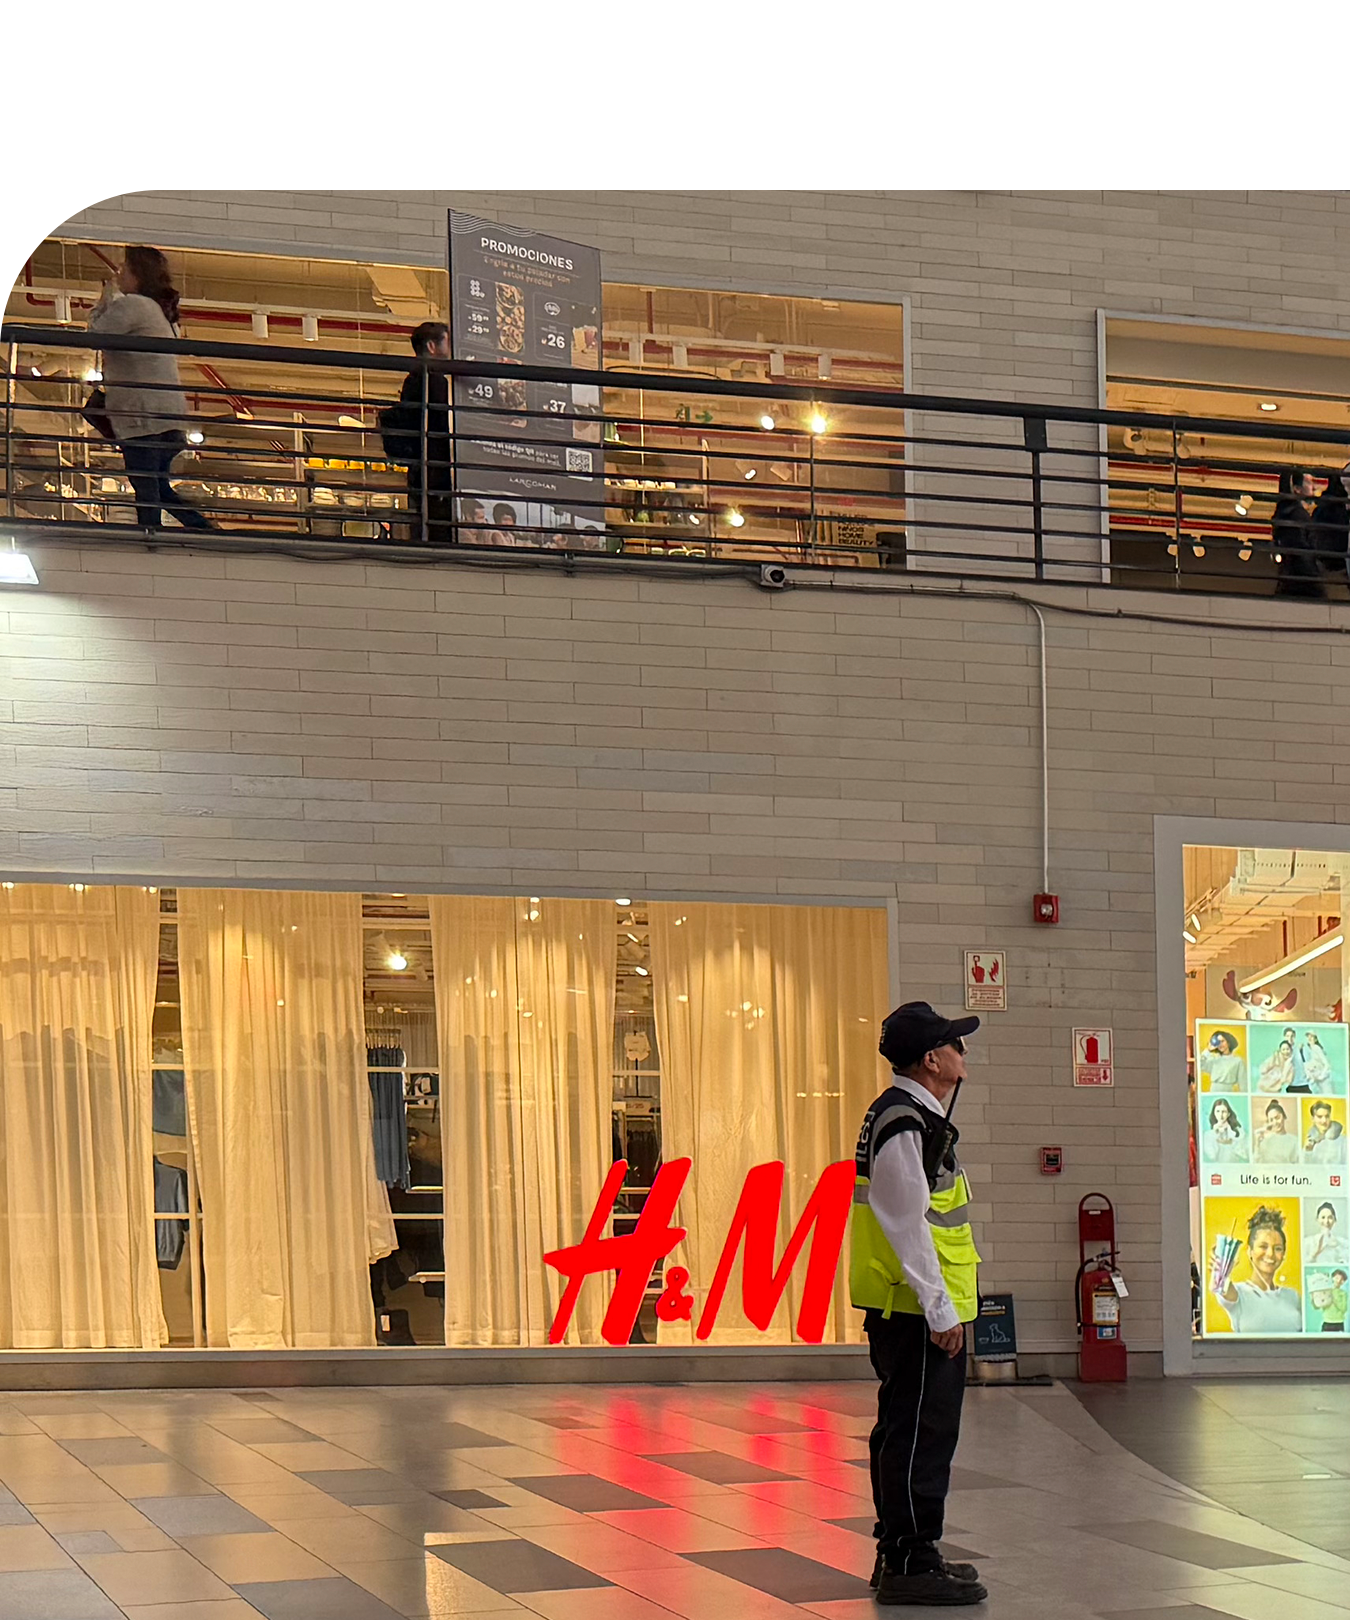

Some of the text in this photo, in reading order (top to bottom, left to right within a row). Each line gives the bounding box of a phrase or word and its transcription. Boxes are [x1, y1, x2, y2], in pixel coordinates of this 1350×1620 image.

[481, 237, 574, 270] PROMOCIONES
[1240, 1174, 1312, 1186] Life is for fun.
[543, 1156, 857, 1345] H&M
